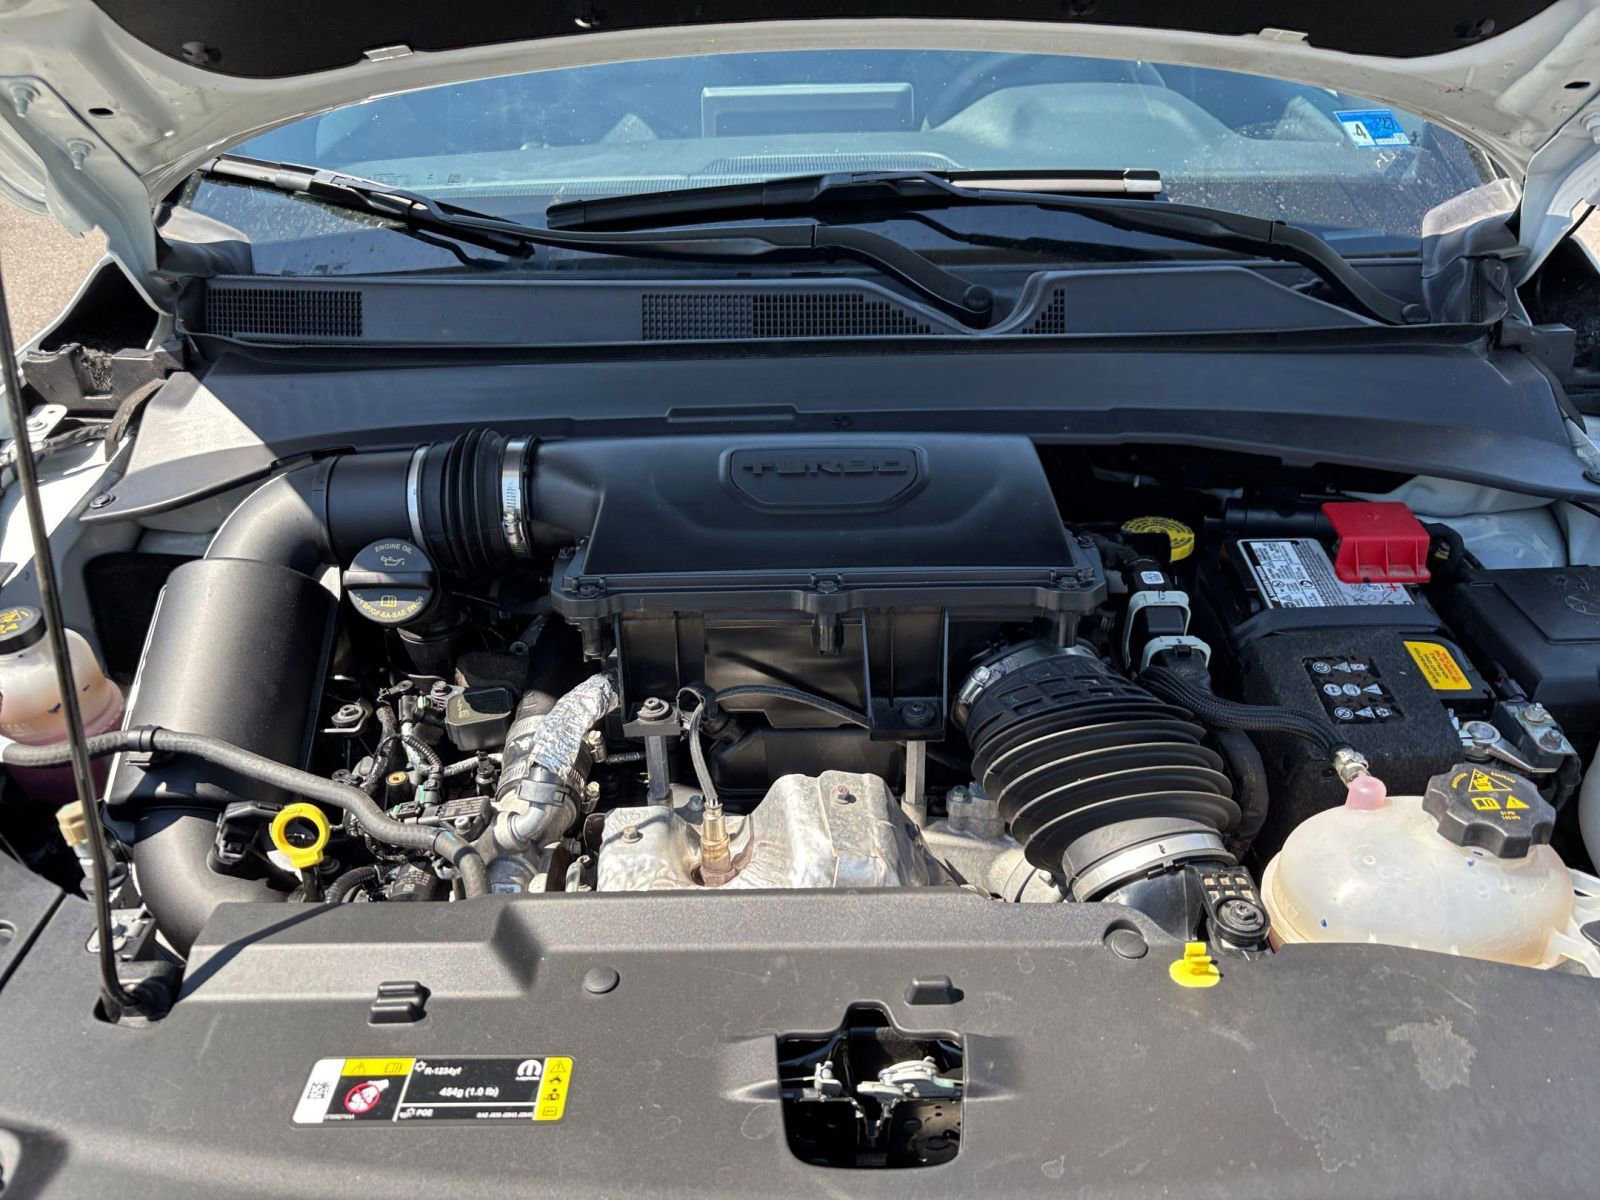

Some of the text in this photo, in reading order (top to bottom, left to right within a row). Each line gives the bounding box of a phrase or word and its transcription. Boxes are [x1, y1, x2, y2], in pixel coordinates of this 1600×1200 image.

[375, 543, 413, 554] ENGINE OIL
[424, 1066, 462, 1077] R-1234yf
[439, 1086, 499, 1098] 454g (1.0 lb)
